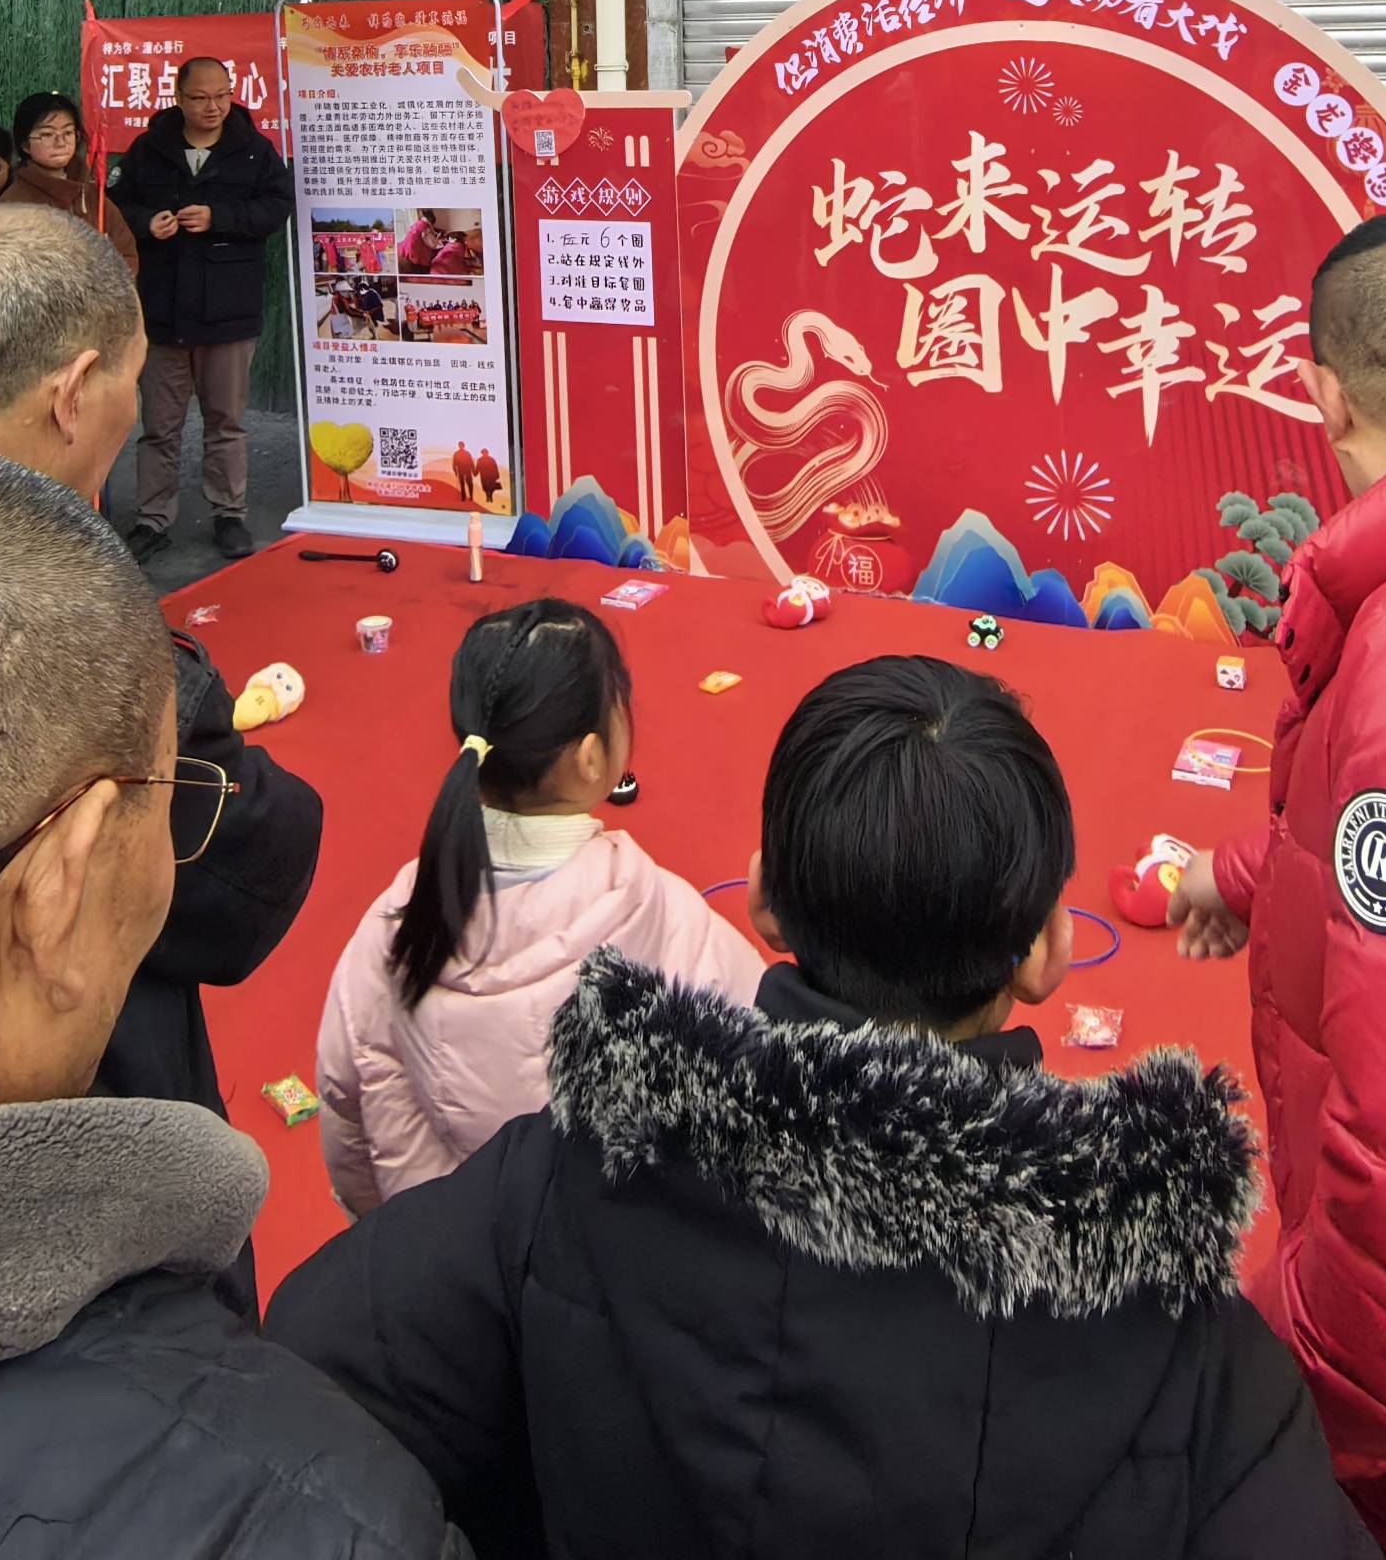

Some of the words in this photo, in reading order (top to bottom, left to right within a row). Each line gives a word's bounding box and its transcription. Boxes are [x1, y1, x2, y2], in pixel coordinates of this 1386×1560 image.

[330, 61, 444, 77] 关爱农村老人项目
[542, 185, 643, 206] 游戏规则
[812, 130, 1256, 280] 蛇来运转
[896, 265, 1324, 445] 圈中幸运
[848, 553, 874, 584] 福
